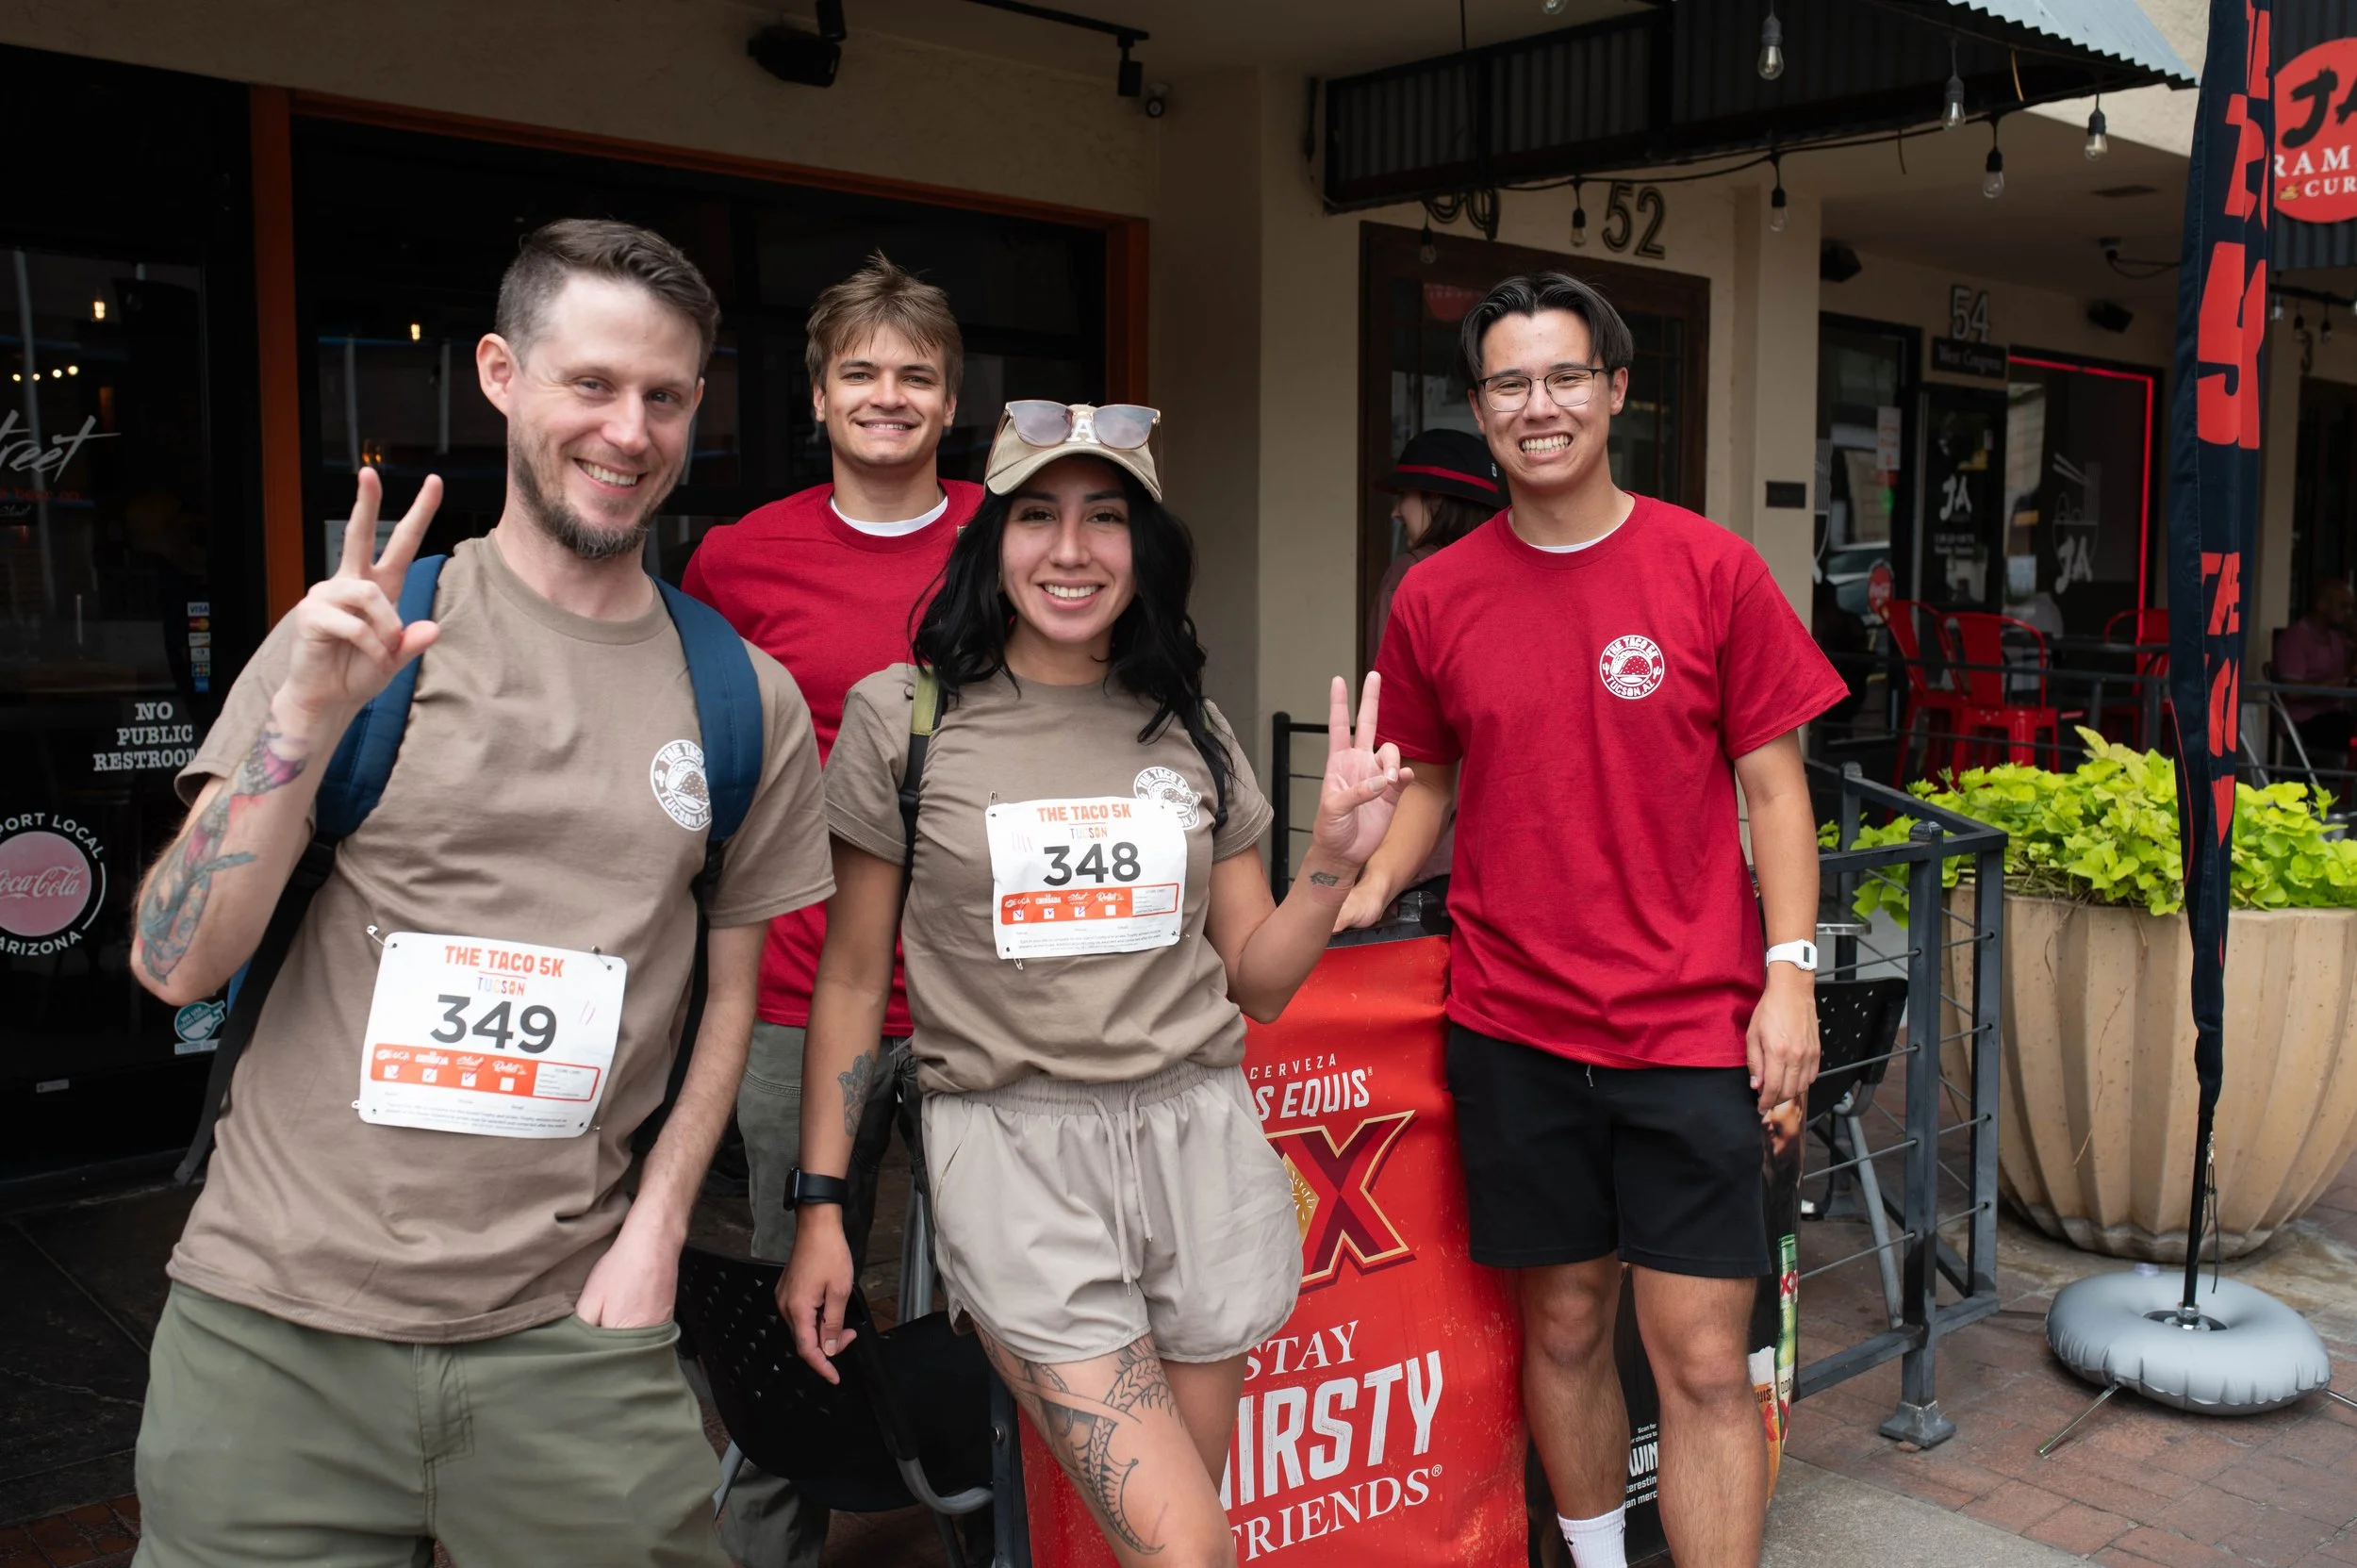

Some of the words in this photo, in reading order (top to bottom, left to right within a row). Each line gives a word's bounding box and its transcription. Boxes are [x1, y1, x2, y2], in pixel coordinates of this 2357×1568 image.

[2274, 144, 2357, 178] RAM
[1602, 181, 1667, 260] 52
[1951, 285, 1990, 343] 54
[1065, 419, 1101, 444] A
[190, 604, 209, 614] VISA
[1606, 641, 1624, 658] THE
[1624, 637, 1648, 649] TACO
[135, 701, 173, 720] NO
[116, 724, 193, 746] PUBLIC
[659, 742, 684, 766] THE
[1137, 772, 1155, 789] THE
[1037, 806, 1068, 822] THE
[1071, 804, 1110, 820] TACO
[1111, 803, 1132, 818] 5K
[52, 815, 105, 860] LOCAL
[1069, 827, 1108, 840] TUCSON
[1043, 841, 1141, 886] 348
[445, 946, 482, 966] THE
[488, 950, 536, 974] TACO
[539, 957, 566, 978] 5K
[477, 977, 526, 997] TUCSON
[430, 994, 557, 1053] 349
[1249, 1053, 1337, 1080] CERVEZA
[1244, 1320, 1359, 1380] STAY
[1635, 1432, 1652, 1443] chance
[1638, 1426, 1649, 1434] Scan
[1629, 1441, 1658, 1477] WIN
